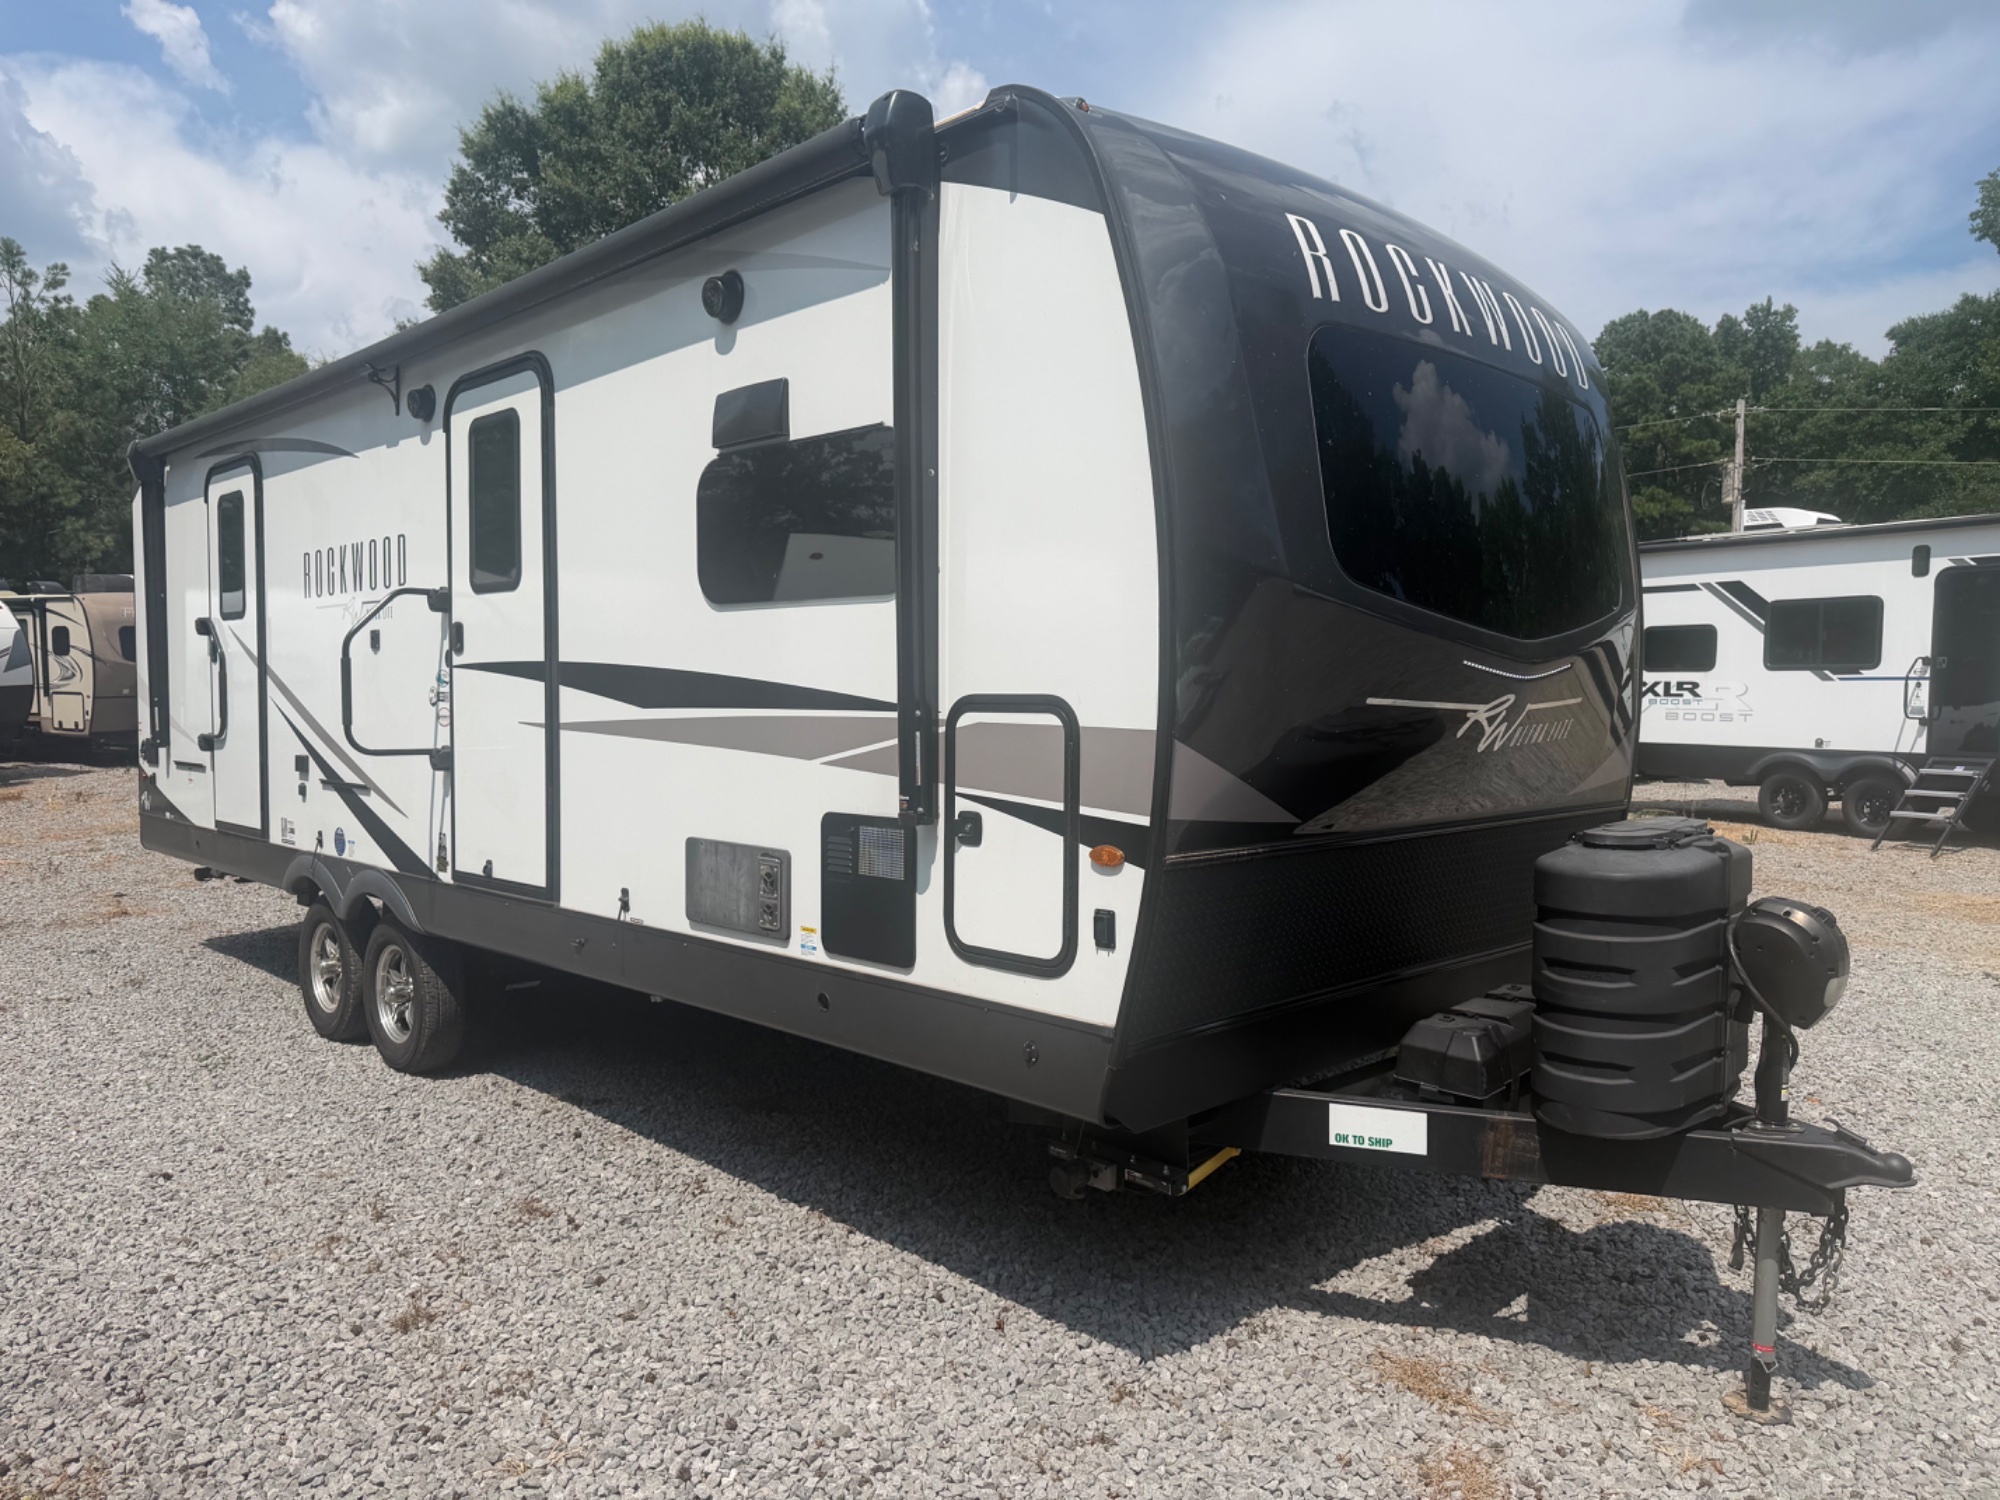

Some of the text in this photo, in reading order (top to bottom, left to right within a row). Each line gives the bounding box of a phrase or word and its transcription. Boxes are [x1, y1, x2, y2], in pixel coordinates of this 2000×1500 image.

[1285, 212, 1589, 390] ROCKWOOD
[303, 533, 406, 599] ROCKWOOD
[1641, 680, 1702, 698] XLR
[1648, 698, 1703, 706] BOOST
[1665, 712, 1753, 722] BOOST
[1335, 1132, 1393, 1148] OK TO SHIP
